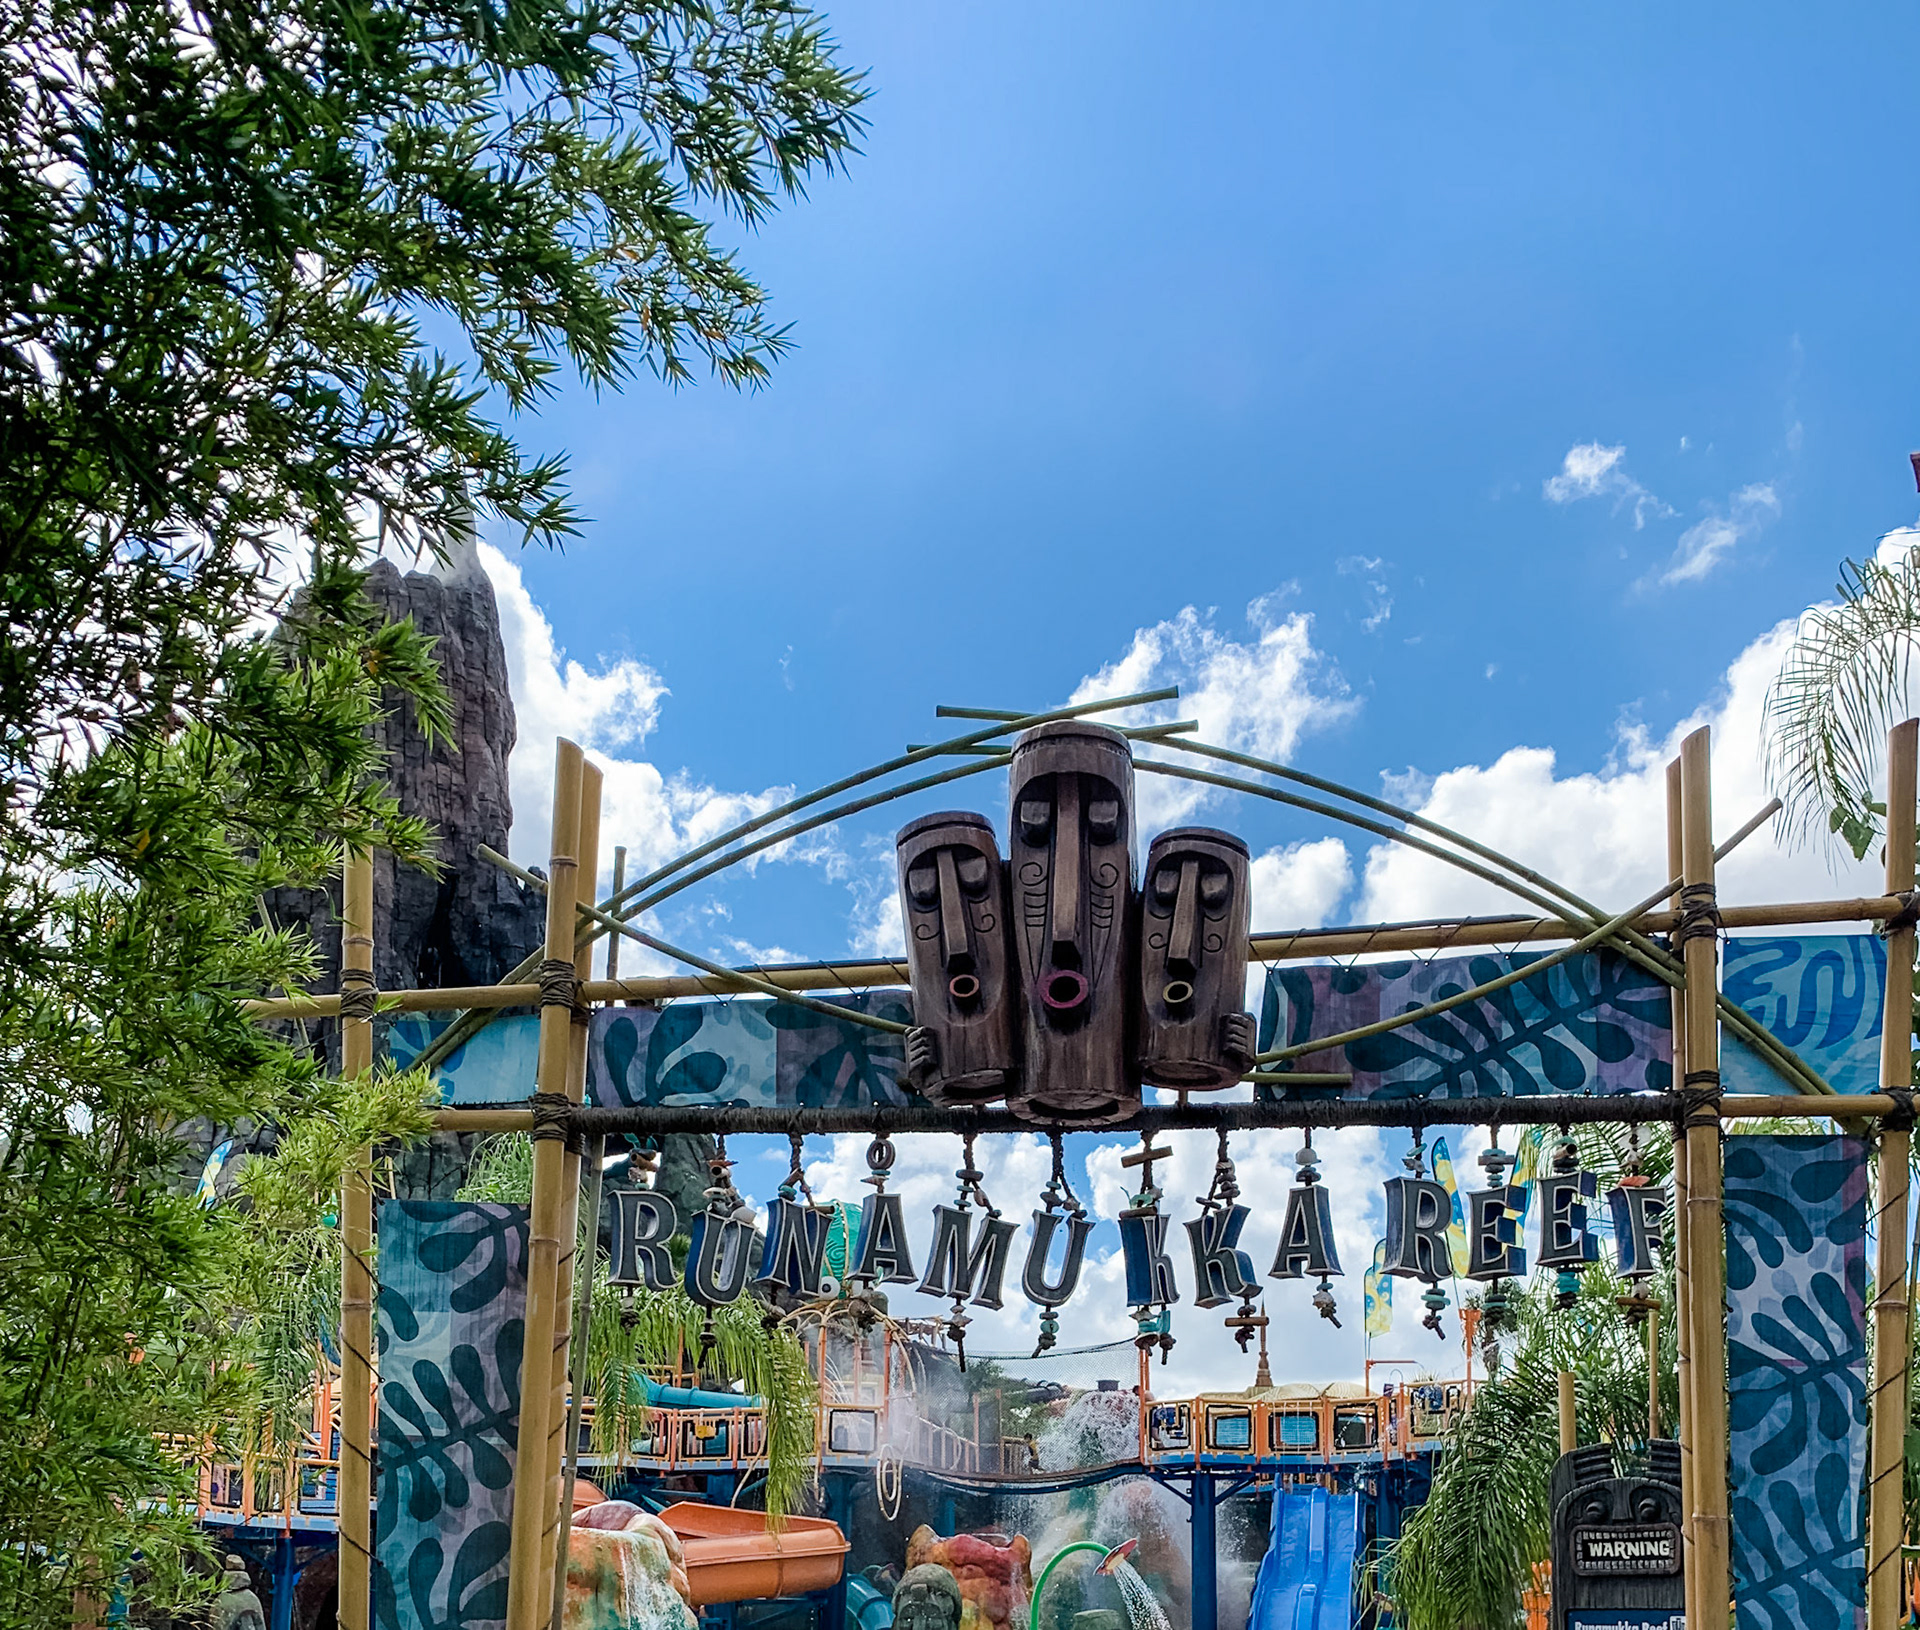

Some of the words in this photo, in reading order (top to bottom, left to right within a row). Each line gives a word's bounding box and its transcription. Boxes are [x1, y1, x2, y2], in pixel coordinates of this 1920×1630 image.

[604, 1185, 1345, 1310] RUNAMUKKA
[1381, 1170, 1668, 1284] REEF
[1588, 1540, 1670, 1559] WARNING
